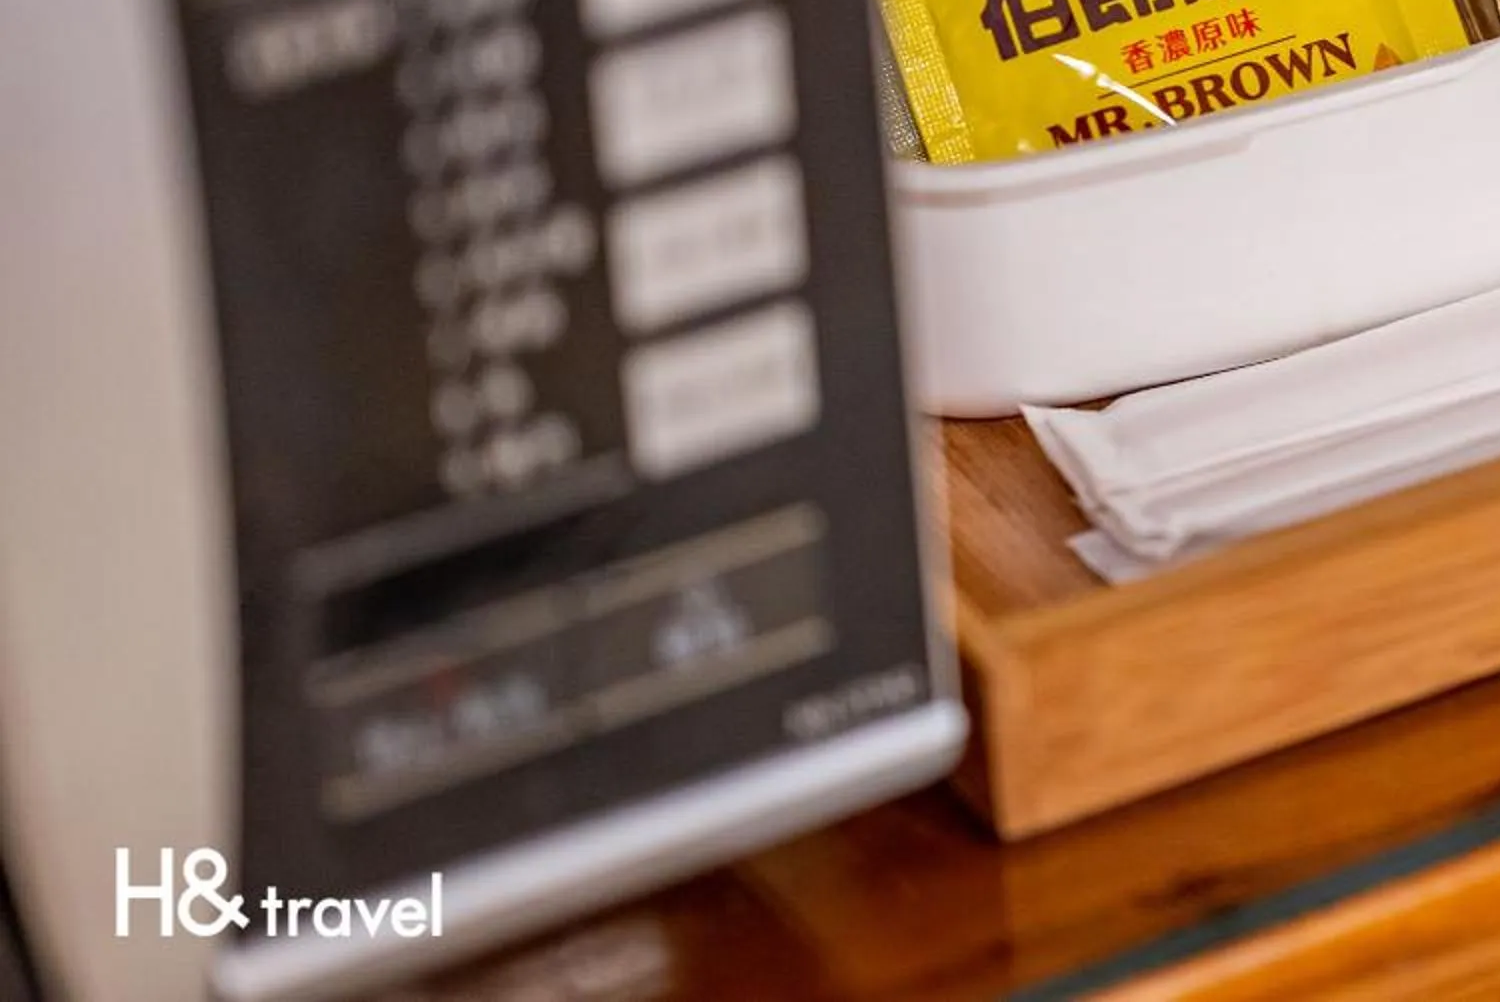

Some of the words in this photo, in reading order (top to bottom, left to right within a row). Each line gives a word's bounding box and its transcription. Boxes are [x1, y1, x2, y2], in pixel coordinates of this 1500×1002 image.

[1119, 7, 1264, 75] 香濃原味
[1152, 32, 1358, 123] BROWN
